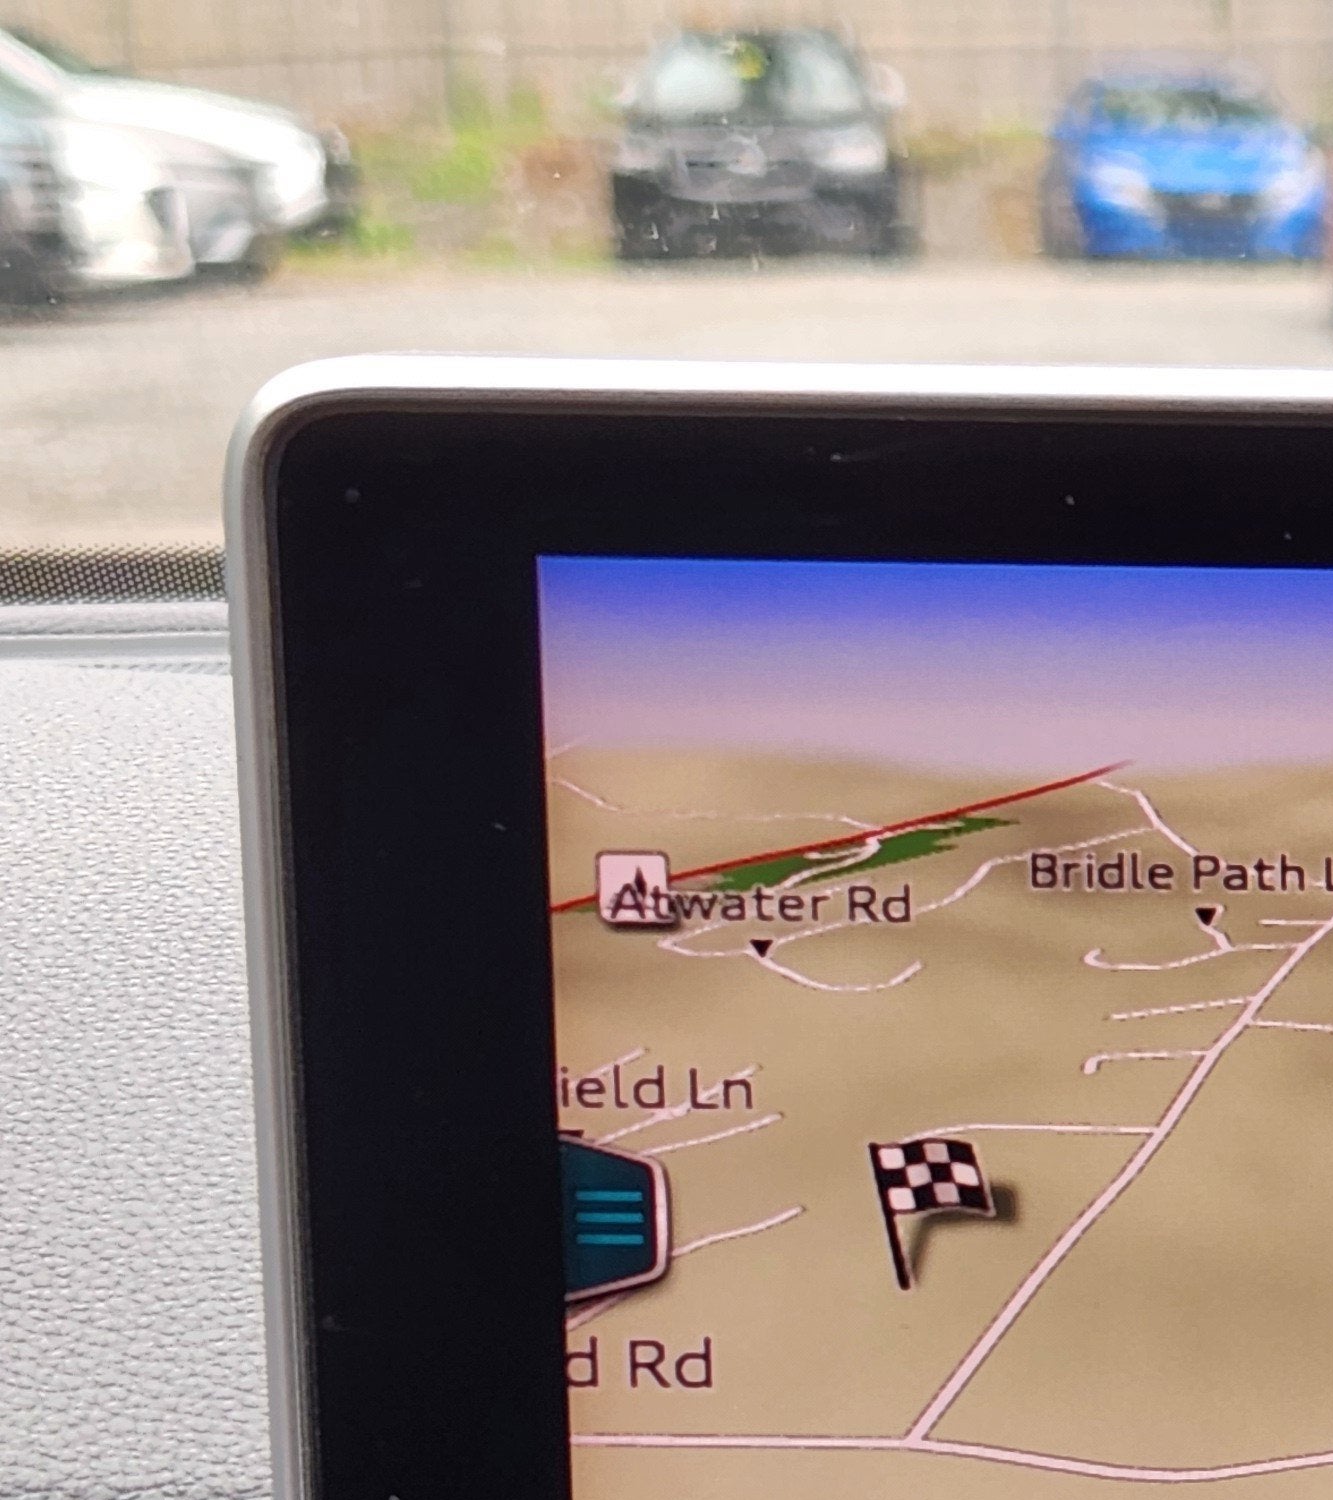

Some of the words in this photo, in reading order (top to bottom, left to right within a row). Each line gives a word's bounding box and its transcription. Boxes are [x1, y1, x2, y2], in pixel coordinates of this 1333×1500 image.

[1030, 852, 1176, 892] Bridle
[1193, 855, 1307, 893] Path
[610, 882, 830, 922] Atwater
[847, 883, 912, 923] Rd
[689, 1067, 754, 1110] Ln
[628, 1335, 713, 1389] Rd
